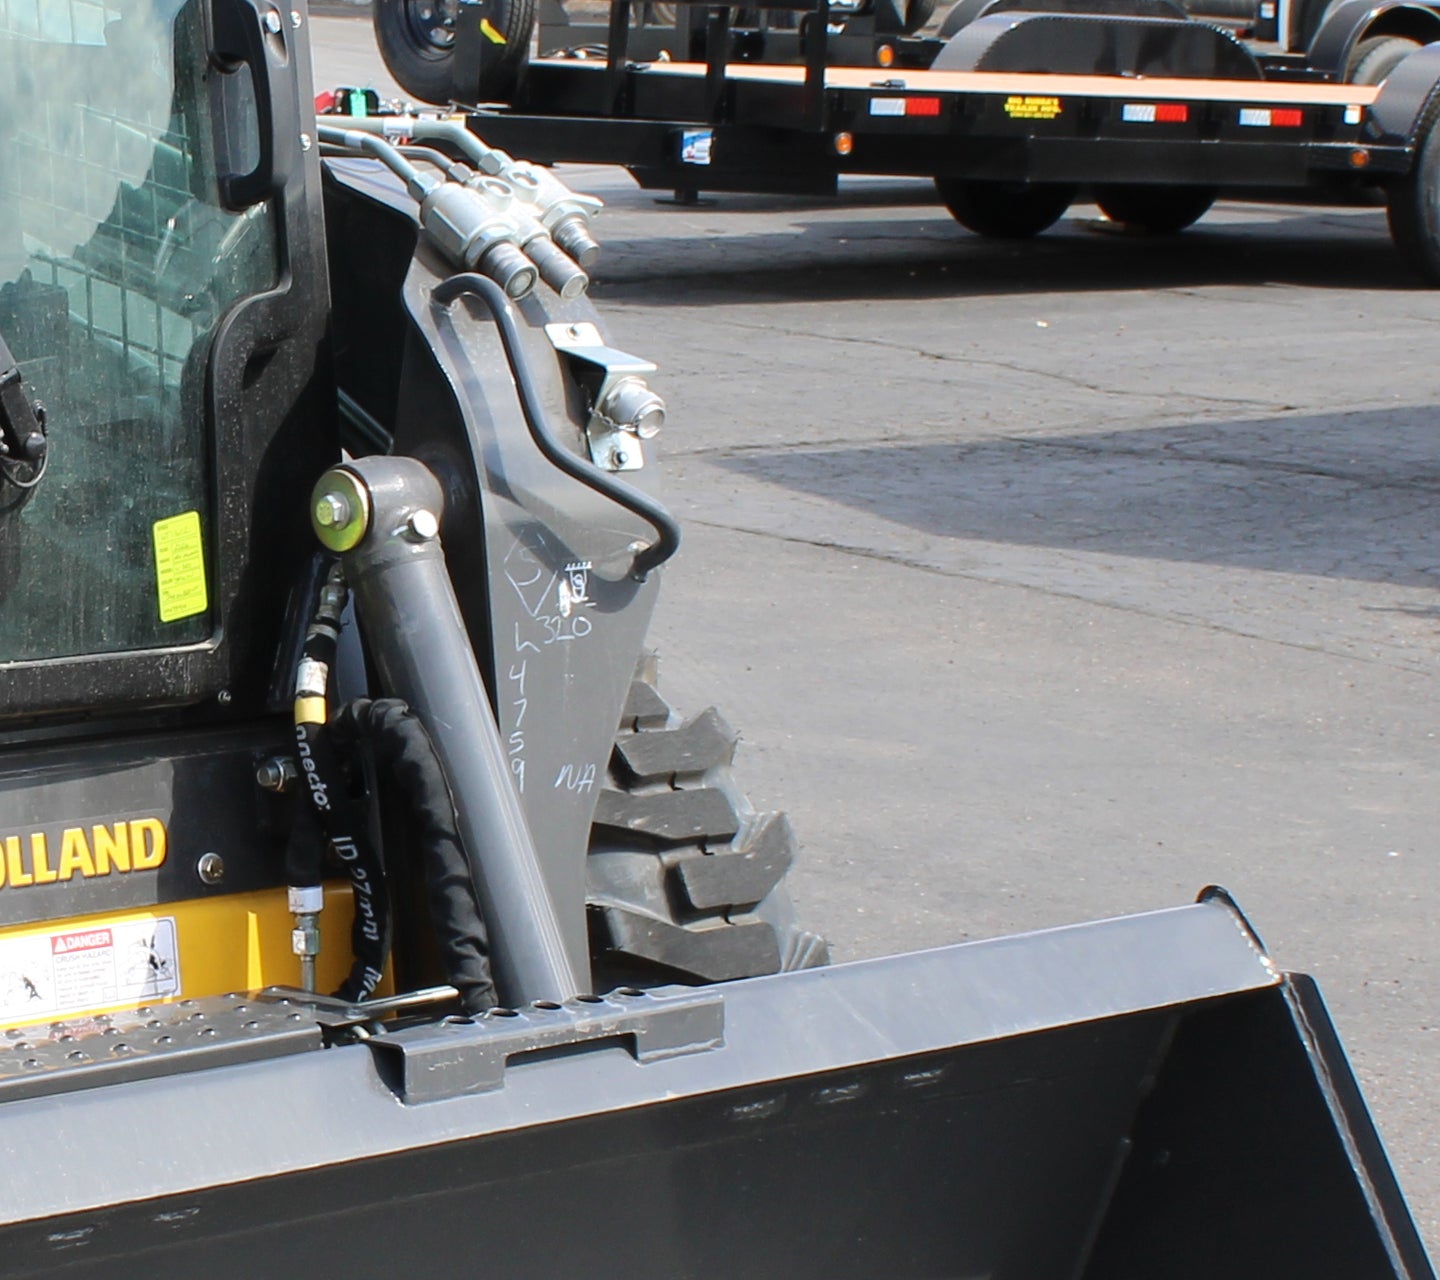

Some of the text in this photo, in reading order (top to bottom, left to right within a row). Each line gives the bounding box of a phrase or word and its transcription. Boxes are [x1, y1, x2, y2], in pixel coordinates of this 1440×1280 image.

[65, 932, 109, 950] DANGER
[55, 949, 112, 963] CRUSH HAZARD
